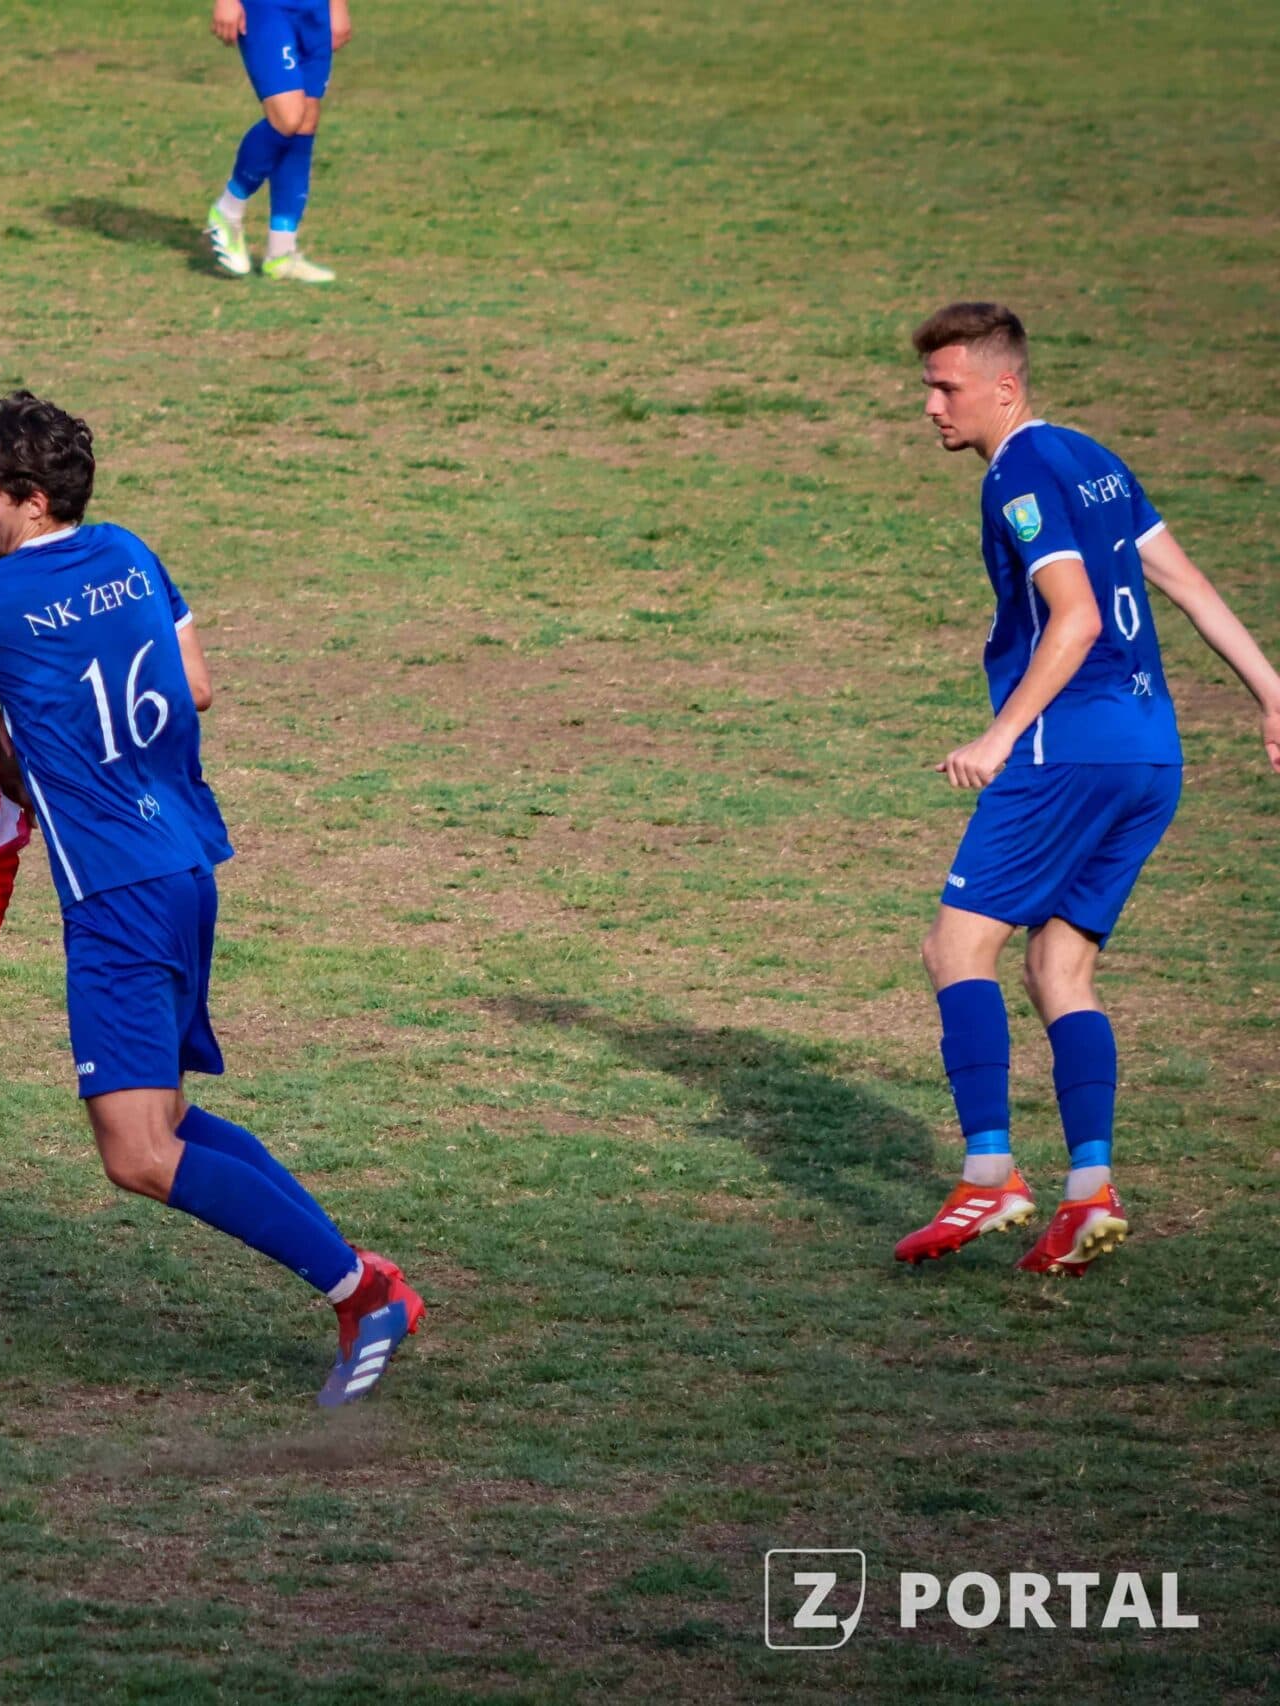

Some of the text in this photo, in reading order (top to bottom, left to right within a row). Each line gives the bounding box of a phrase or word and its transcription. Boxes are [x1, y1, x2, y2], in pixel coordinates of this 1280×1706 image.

[282, 46, 296, 70] 5
[23, 598, 81, 636] NK
[80, 639, 168, 764] 16
